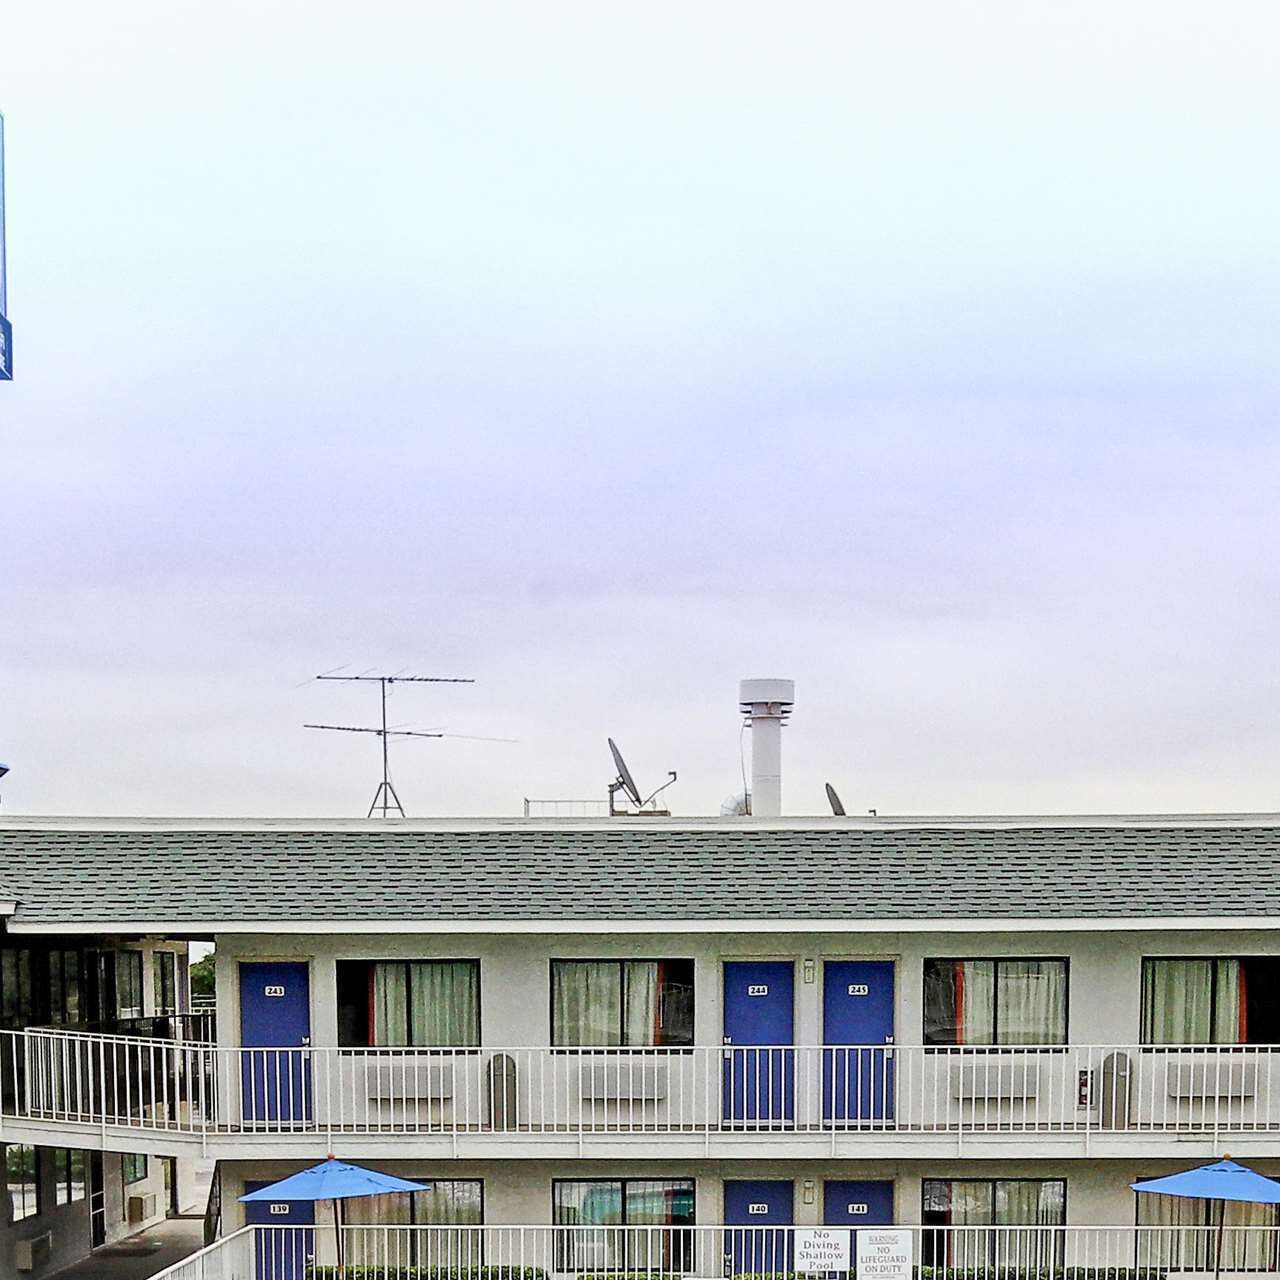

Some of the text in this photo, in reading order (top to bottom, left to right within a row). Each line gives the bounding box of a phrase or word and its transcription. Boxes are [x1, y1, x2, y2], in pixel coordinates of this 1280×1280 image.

[804, 1241, 840, 1250] Diving
[800, 1251, 844, 1259] Shallow
[860, 1256, 907, 1264] LIFEGUARD
[809, 1261, 833, 1269] Pool
